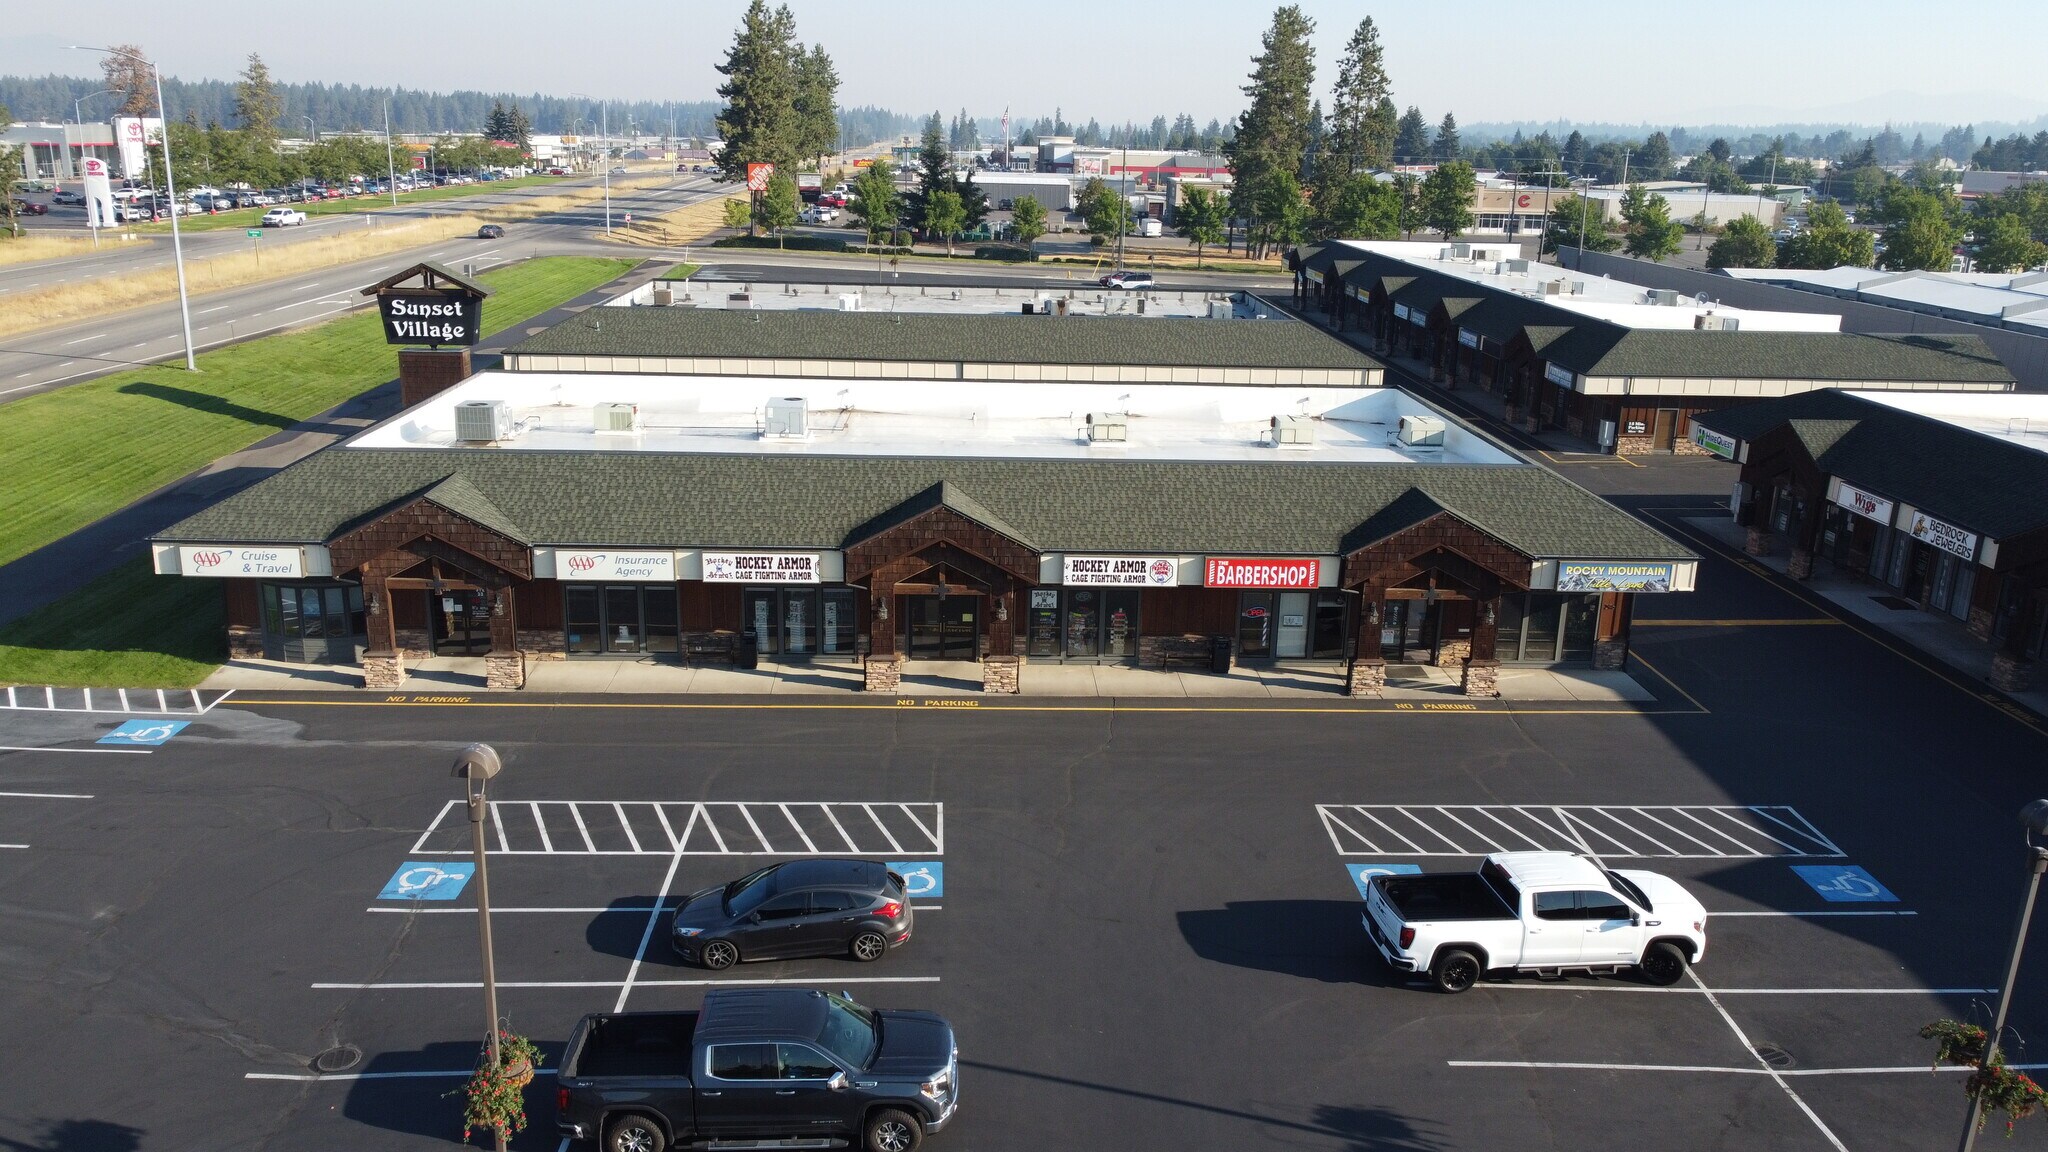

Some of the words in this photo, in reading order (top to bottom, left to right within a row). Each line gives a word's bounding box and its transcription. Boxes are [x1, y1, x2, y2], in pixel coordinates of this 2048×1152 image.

[391, 299, 463, 318] Sunset
[391, 321, 465, 341] Village
[1854, 491, 1876, 514] Wigs
[1930, 519, 1969, 546] BEDROCK
[1930, 533, 1972, 559] JEWELERS
[193, 551, 221, 567] AAA
[241, 551, 277, 561] Cruise
[569, 555, 595, 571] AAA
[615, 556, 668, 565] Insurance
[735, 556, 774, 570] HOCKEY
[777, 557, 812, 570] ARMOR
[242, 563, 252, 573] &
[256, 563, 292, 573] Travel
[615, 567, 653, 577] Agency
[1072, 559, 1110, 573] HOCKEY
[1113, 560, 1147, 573] ARMOR
[1566, 566, 1606, 575] ROCKY
[1608, 566, 1666, 576] MOUNTAIN
[735, 571, 753, 579] CAGE
[755, 571, 786, 580] FIGHTING
[788, 571, 812, 580] ARMOR
[1071, 574, 1088, 582] CAGE
[1090, 574, 1121, 583] FIGHTING
[1123, 575, 1146, 583] ARMOR
[1216, 565, 1307, 585] BARBERSHOP
[1585, 576, 1612, 589] Title
[1615, 577, 1645, 589] Loans
